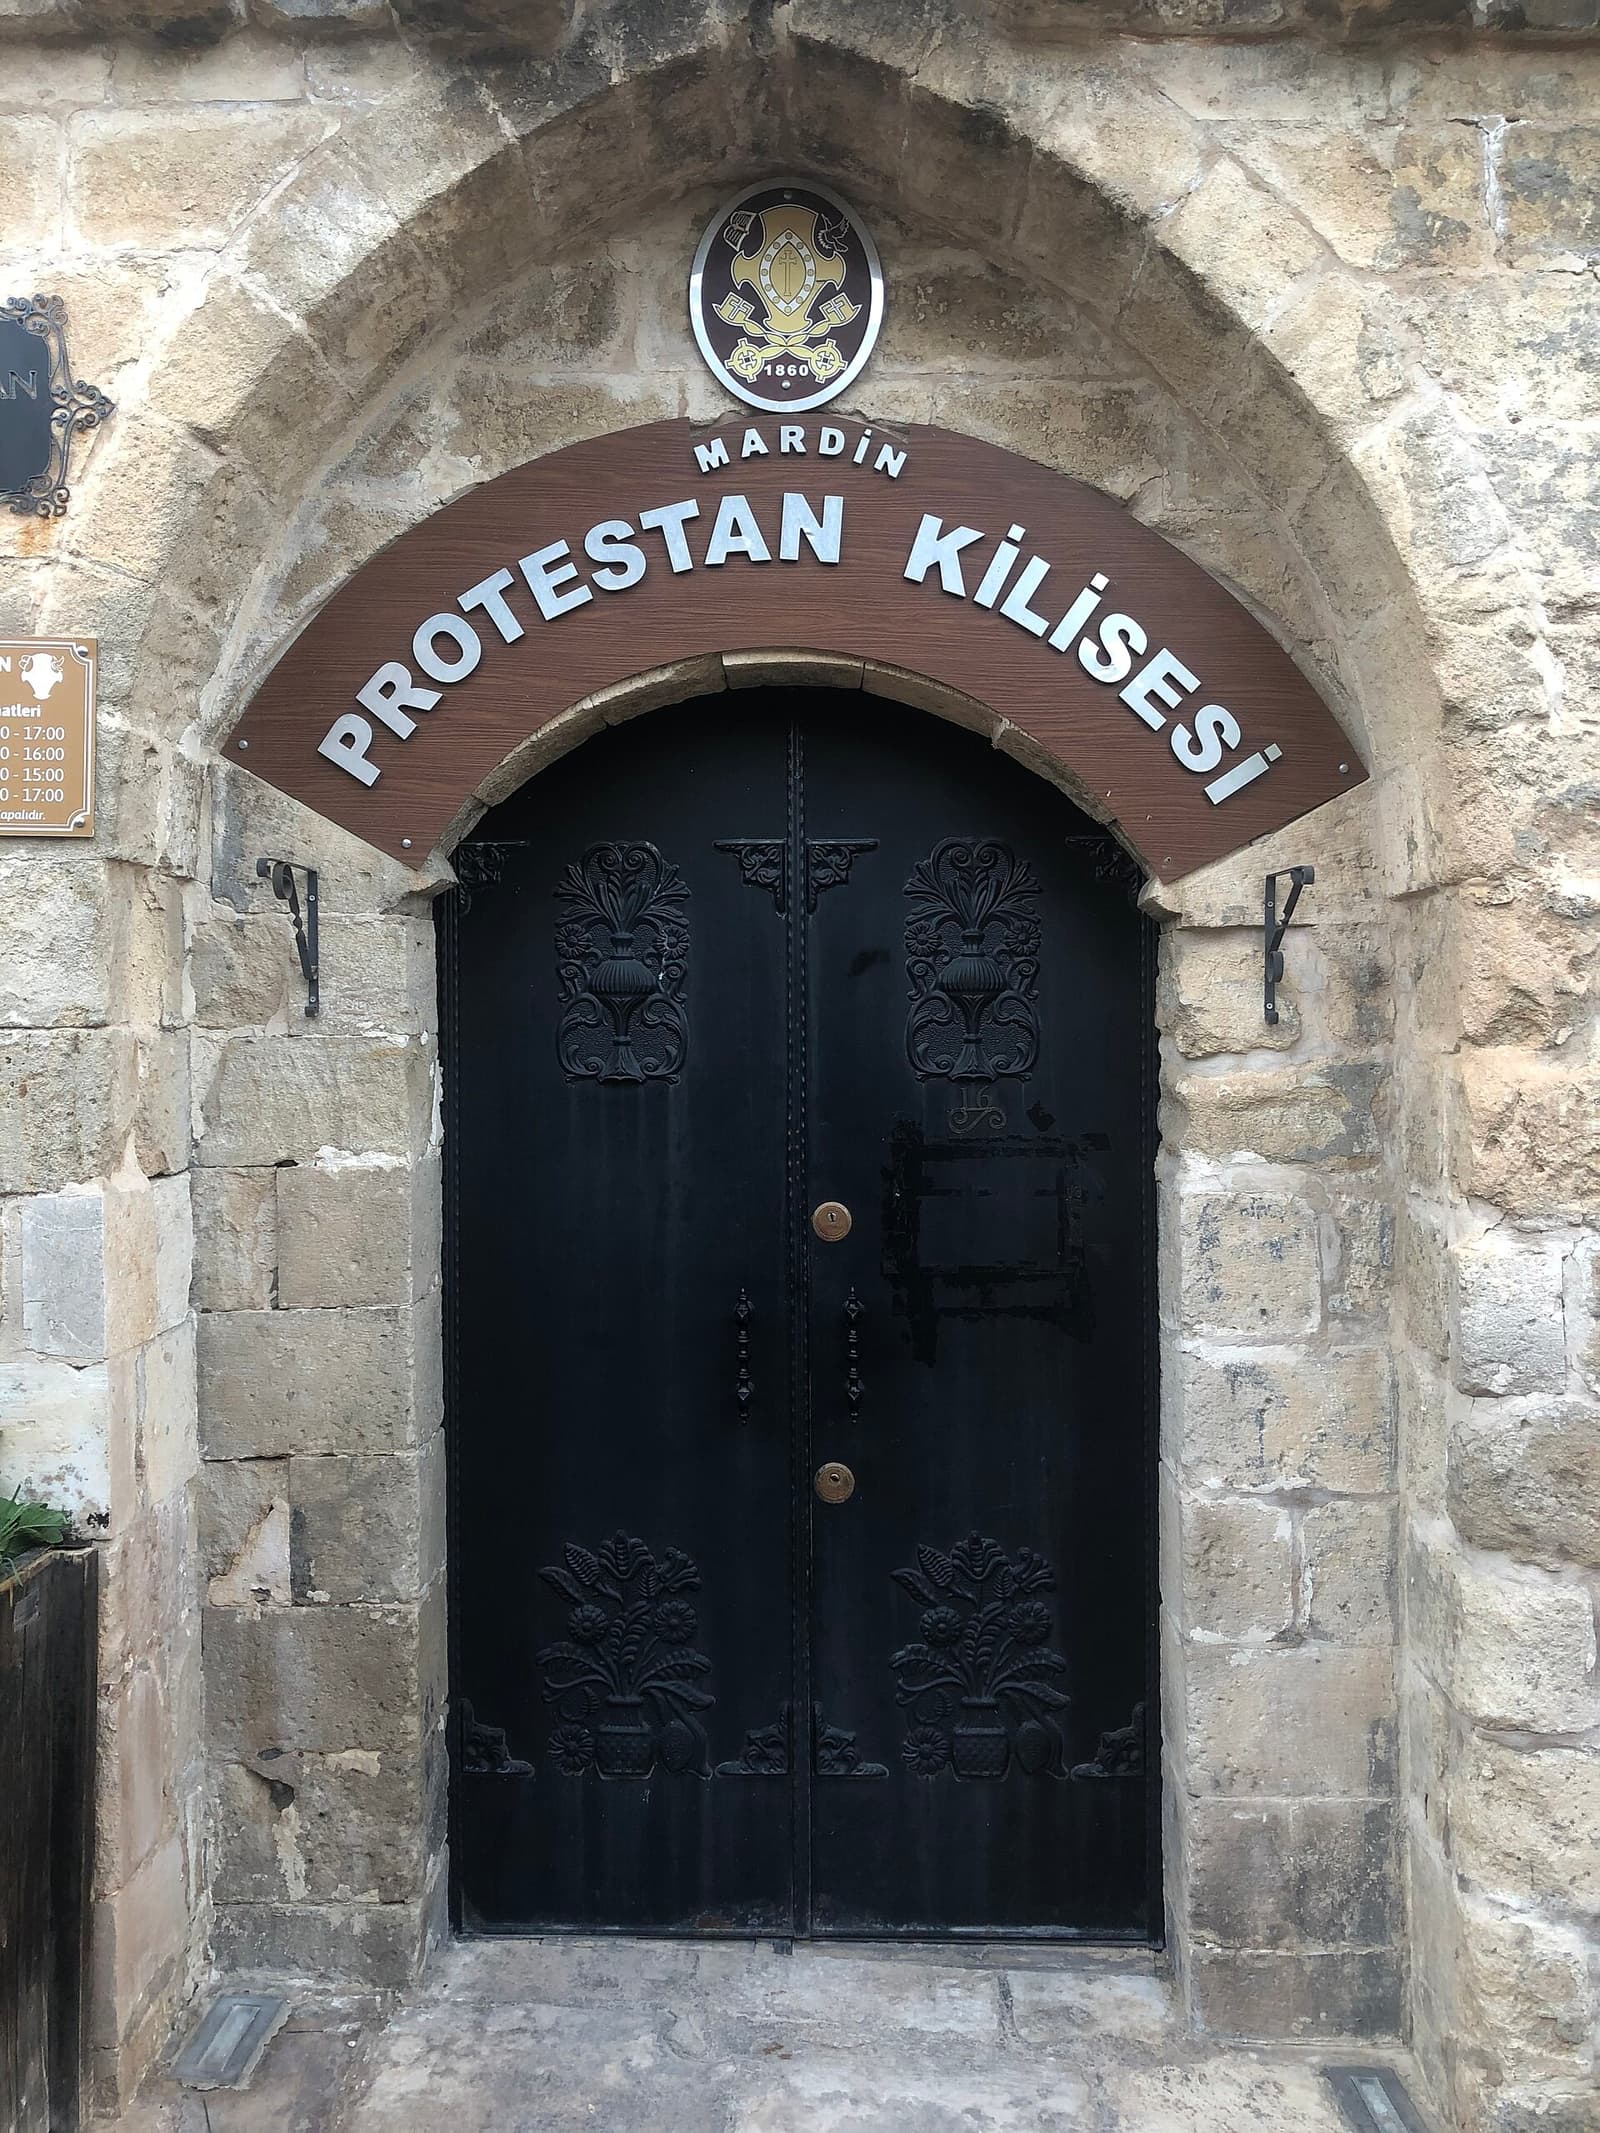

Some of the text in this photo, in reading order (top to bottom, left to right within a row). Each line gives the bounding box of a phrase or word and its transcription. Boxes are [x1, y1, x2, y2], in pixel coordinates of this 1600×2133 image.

[764, 363, 809, 377] 1860
[317, 492, 844, 787] PROTESTAN
[0, 704, 41, 718] atleri
[23, 726, 65, 740] 17:00
[23, 747, 65, 760] 16:00
[23, 768, 64, 781] 15:00
[22, 788, 64, 802] 17:00
